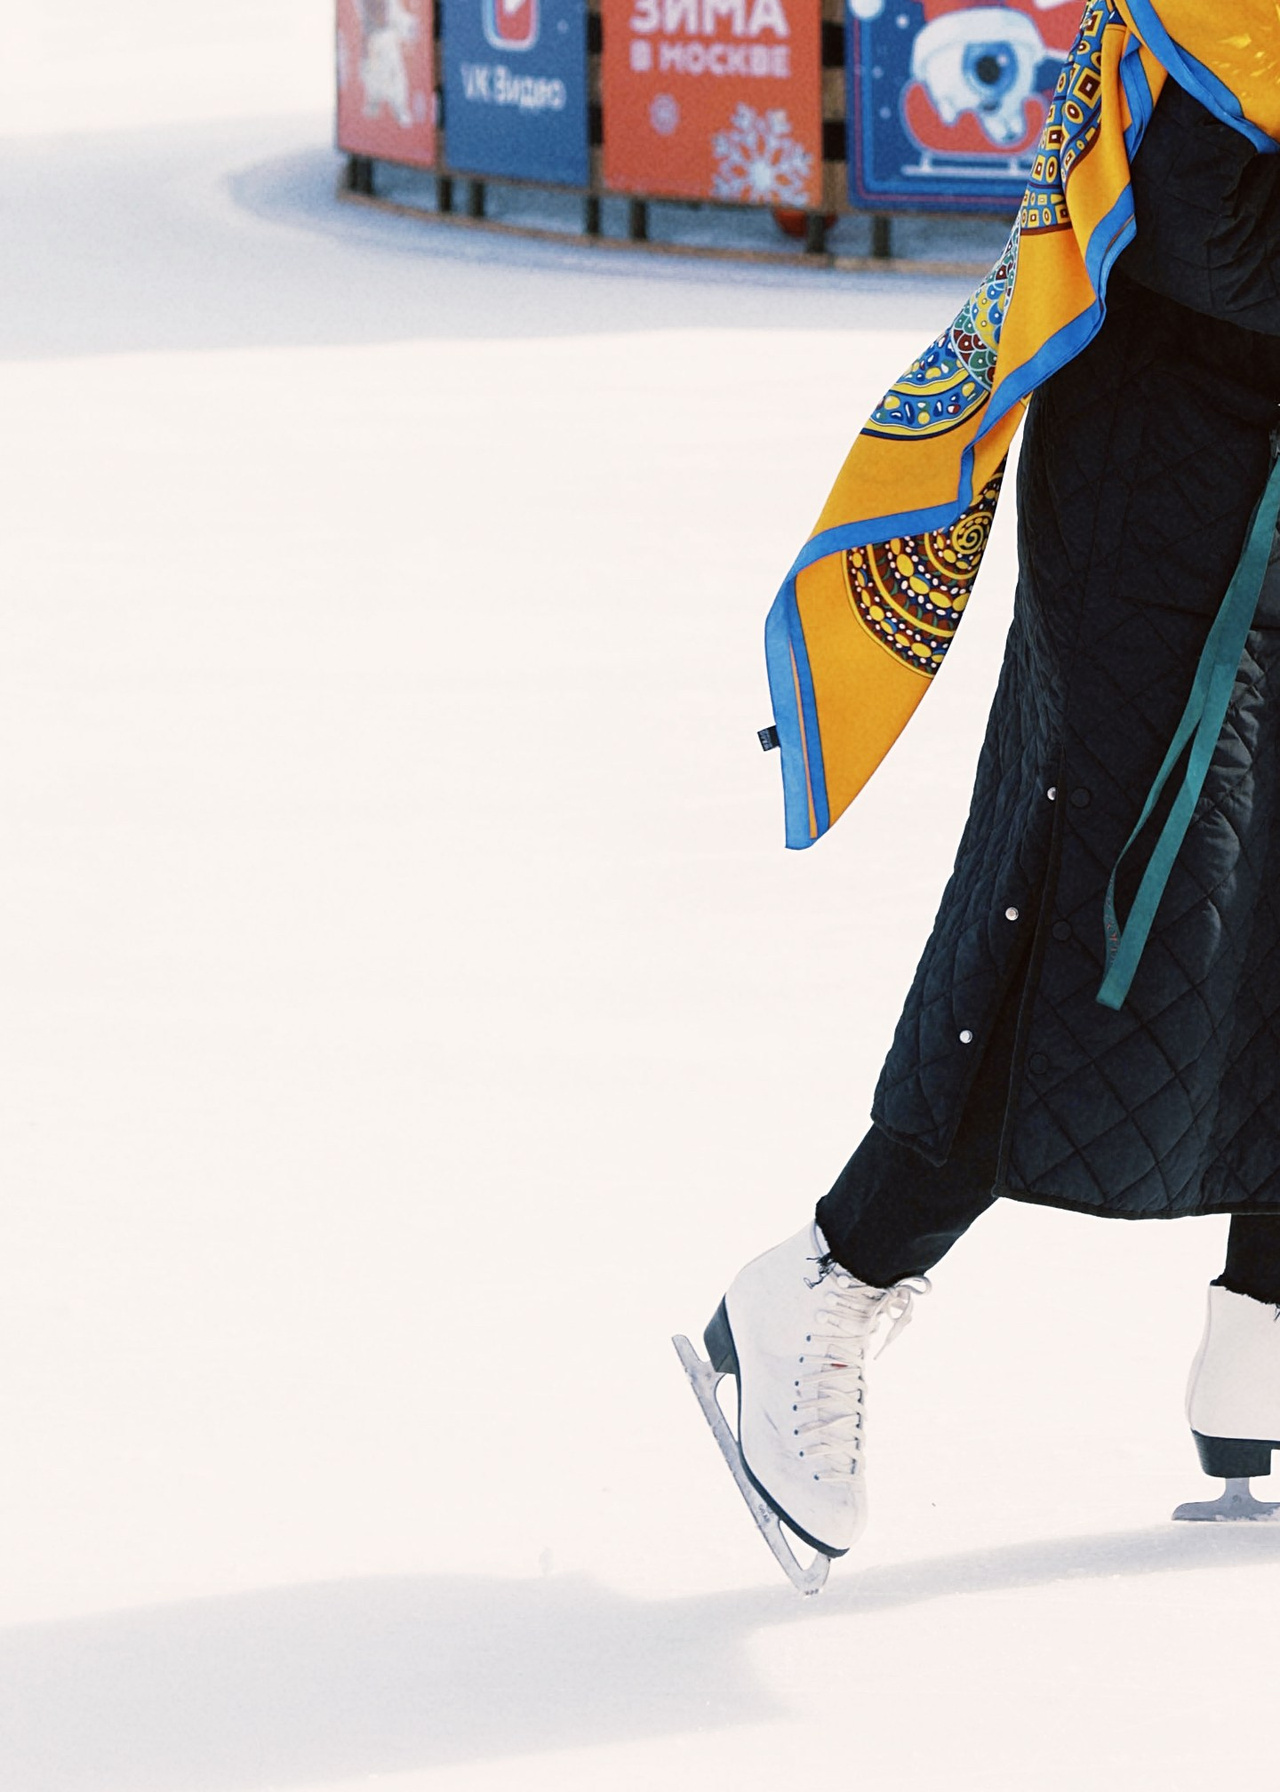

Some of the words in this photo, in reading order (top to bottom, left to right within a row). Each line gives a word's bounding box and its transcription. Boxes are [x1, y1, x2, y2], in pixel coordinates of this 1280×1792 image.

[629, 38, 653, 74] В
[658, 39, 790, 79] МОСКВЕ
[493, 63, 567, 114] Видео
